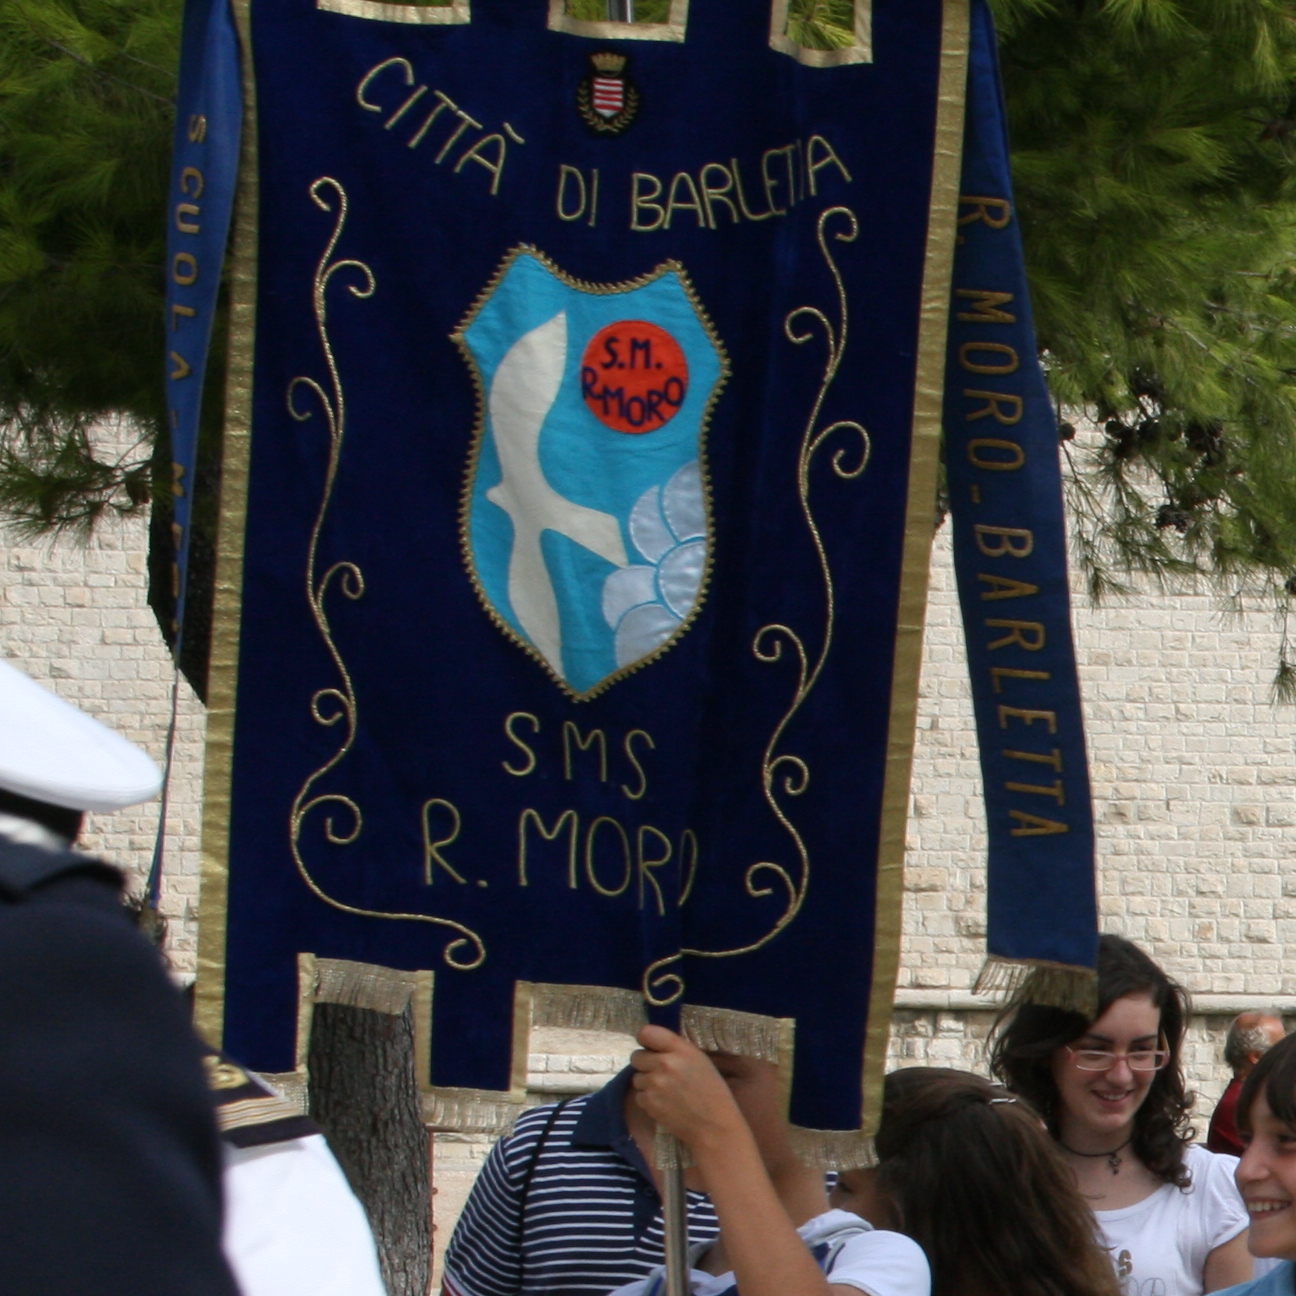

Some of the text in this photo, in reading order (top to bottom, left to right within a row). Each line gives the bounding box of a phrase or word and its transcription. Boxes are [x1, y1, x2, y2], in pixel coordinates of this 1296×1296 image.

[356, 57, 526, 196] CITTÀ
[556, 163, 599, 228] DI
[421, 797, 489, 889] R.
